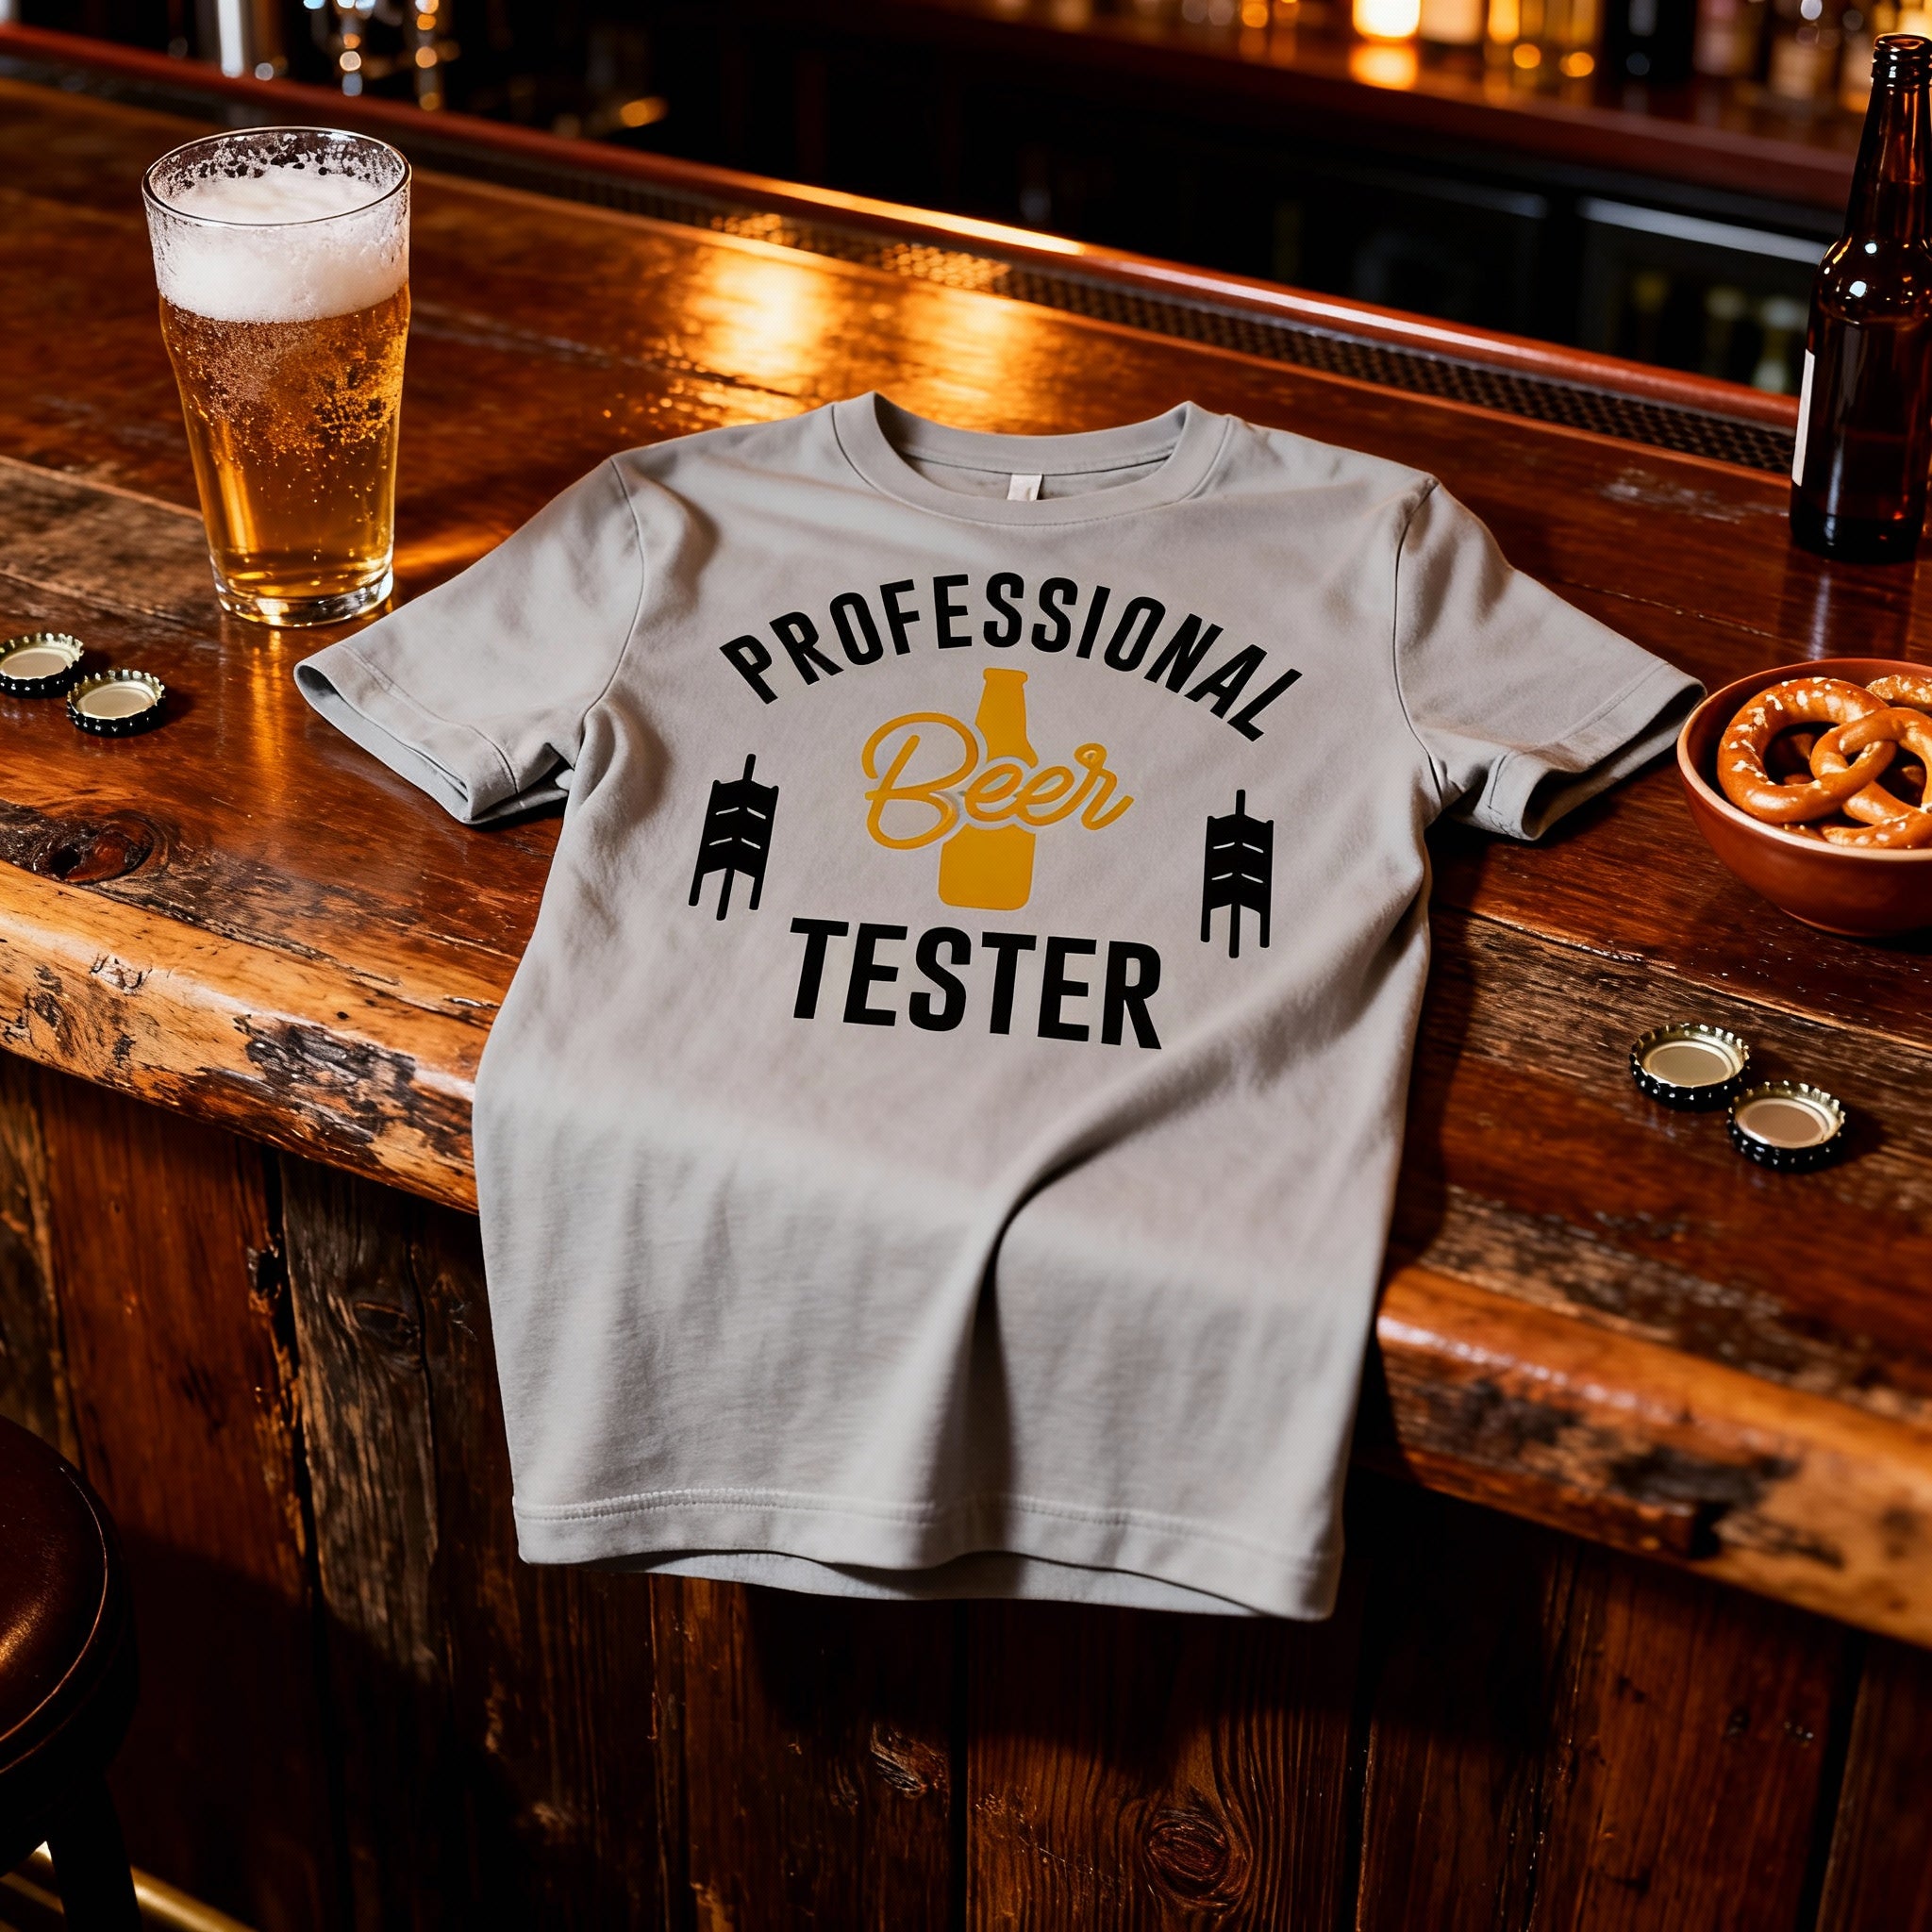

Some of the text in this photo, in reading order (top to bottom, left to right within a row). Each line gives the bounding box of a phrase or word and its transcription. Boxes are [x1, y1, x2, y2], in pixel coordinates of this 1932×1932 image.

[719, 572, 1303, 742] PROFESSIONAL
[860, 711, 1135, 851] Beer
[790, 917, 1162, 1050] TESTER
